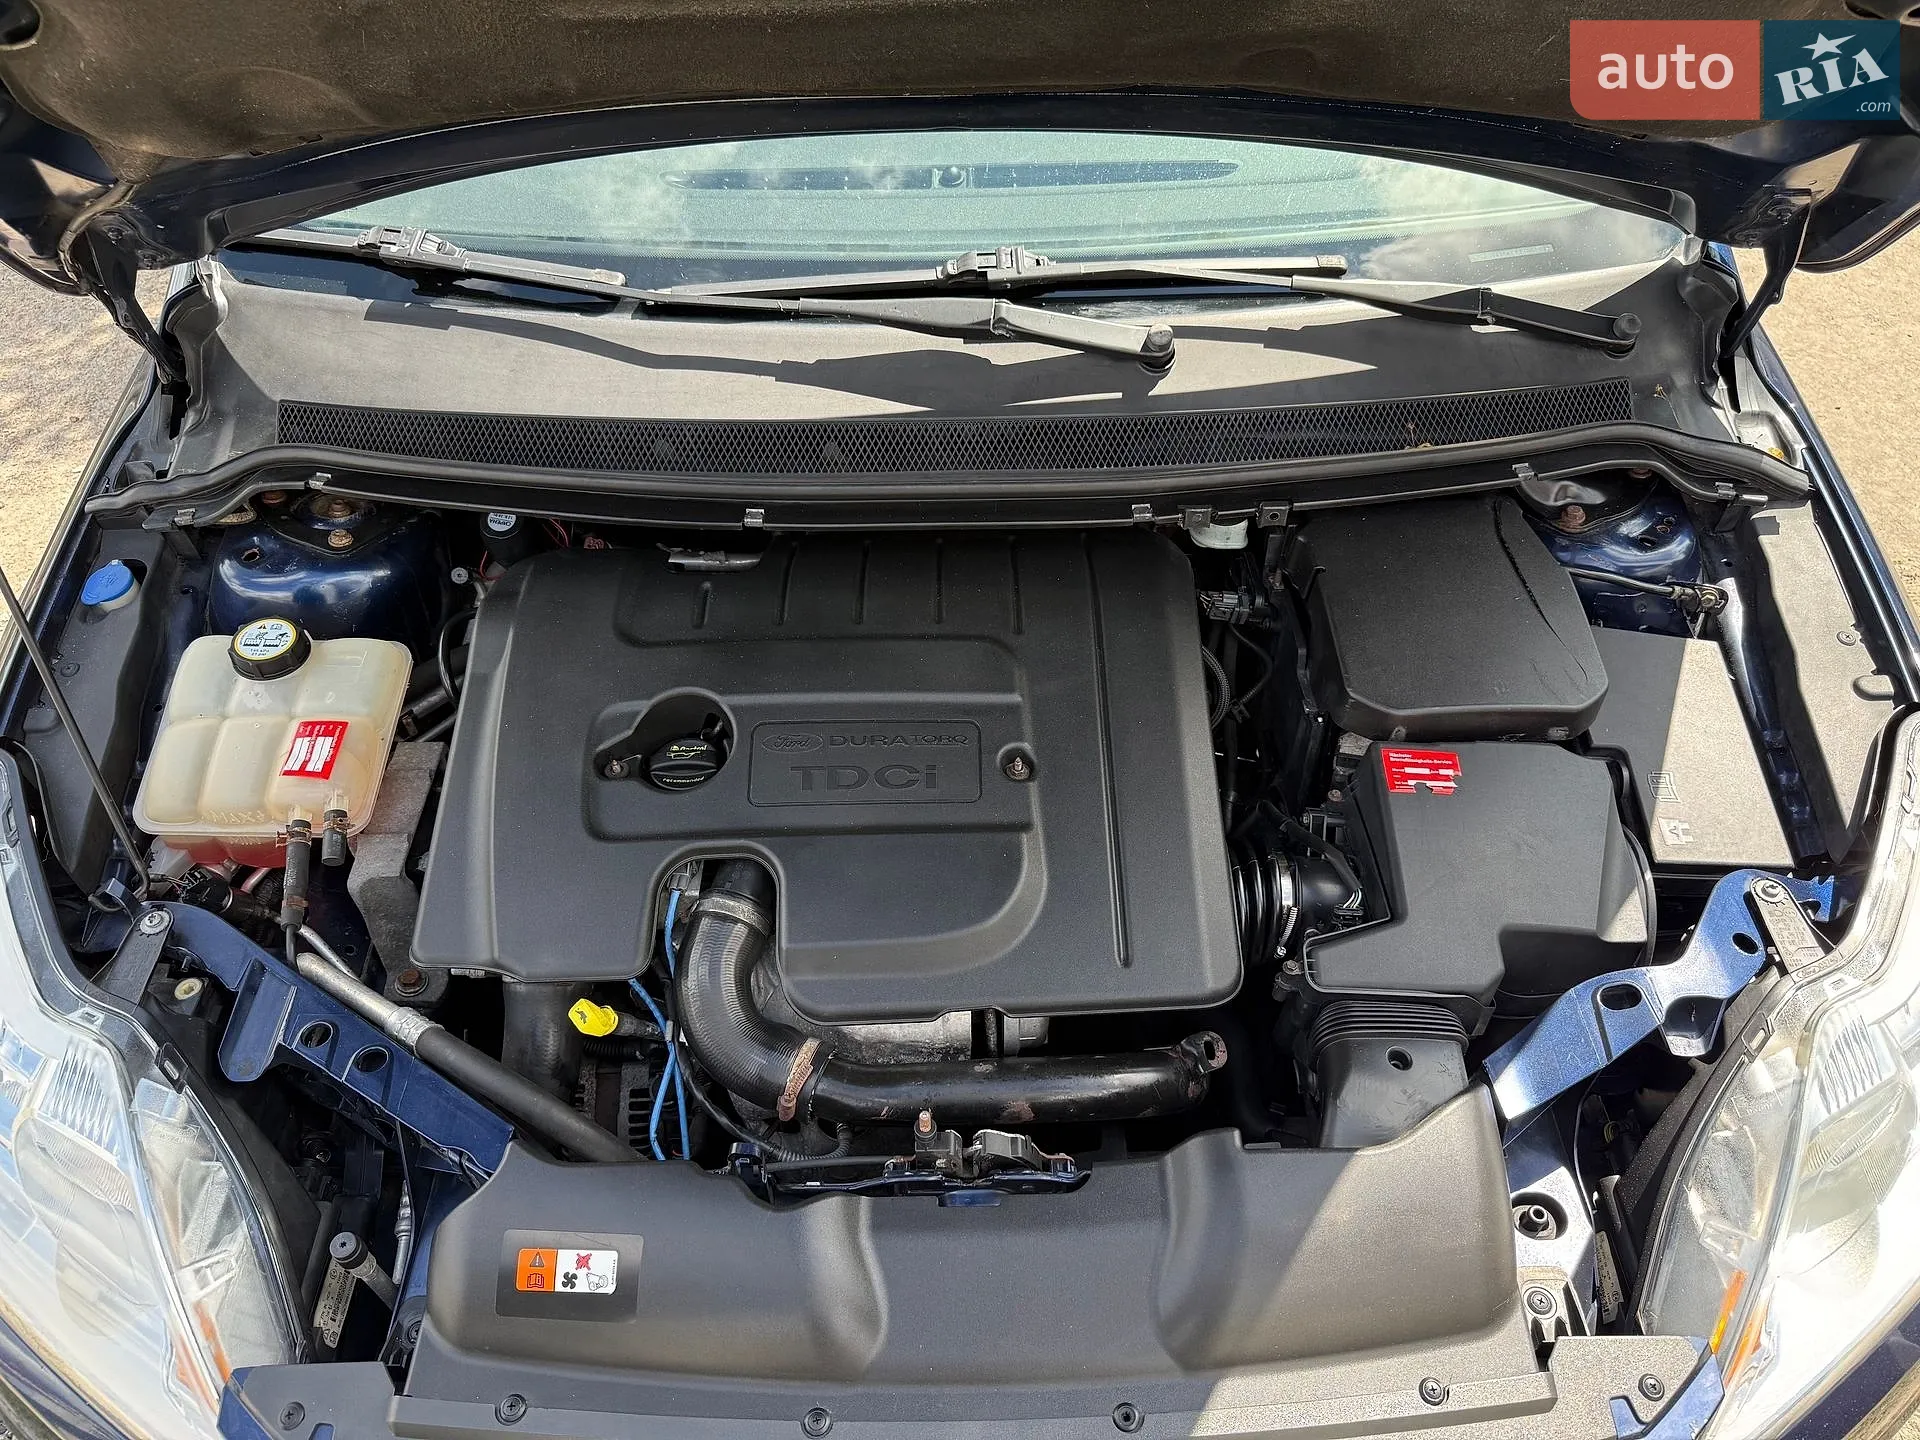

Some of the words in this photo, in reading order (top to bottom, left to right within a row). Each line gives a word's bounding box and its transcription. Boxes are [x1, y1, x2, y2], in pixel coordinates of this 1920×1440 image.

[773, 735, 811, 748] Ford
[829, 735, 969, 747] DURATORQ
[789, 764, 938, 792] TDCi
